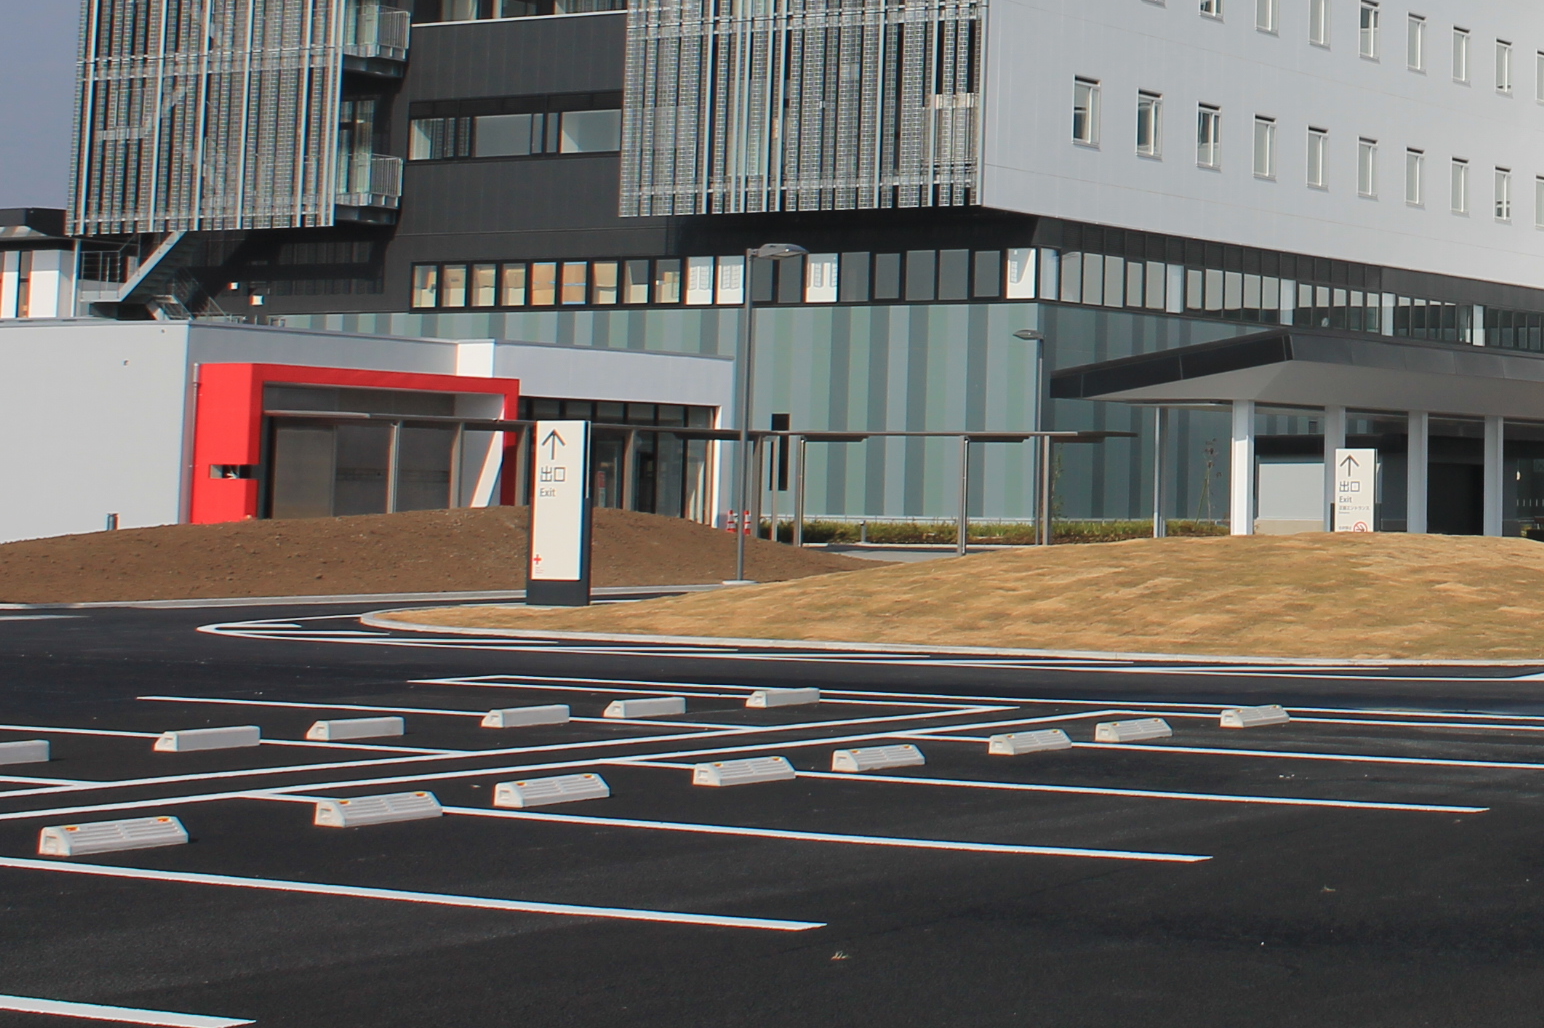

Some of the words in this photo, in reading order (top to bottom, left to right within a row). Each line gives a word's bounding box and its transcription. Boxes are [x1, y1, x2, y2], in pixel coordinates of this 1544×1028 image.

[540, 465, 566, 483] 出口
[540, 487, 556, 498] Exit
[1339, 480, 1360, 493] 出口
[1339, 495, 1352, 503] Exit
